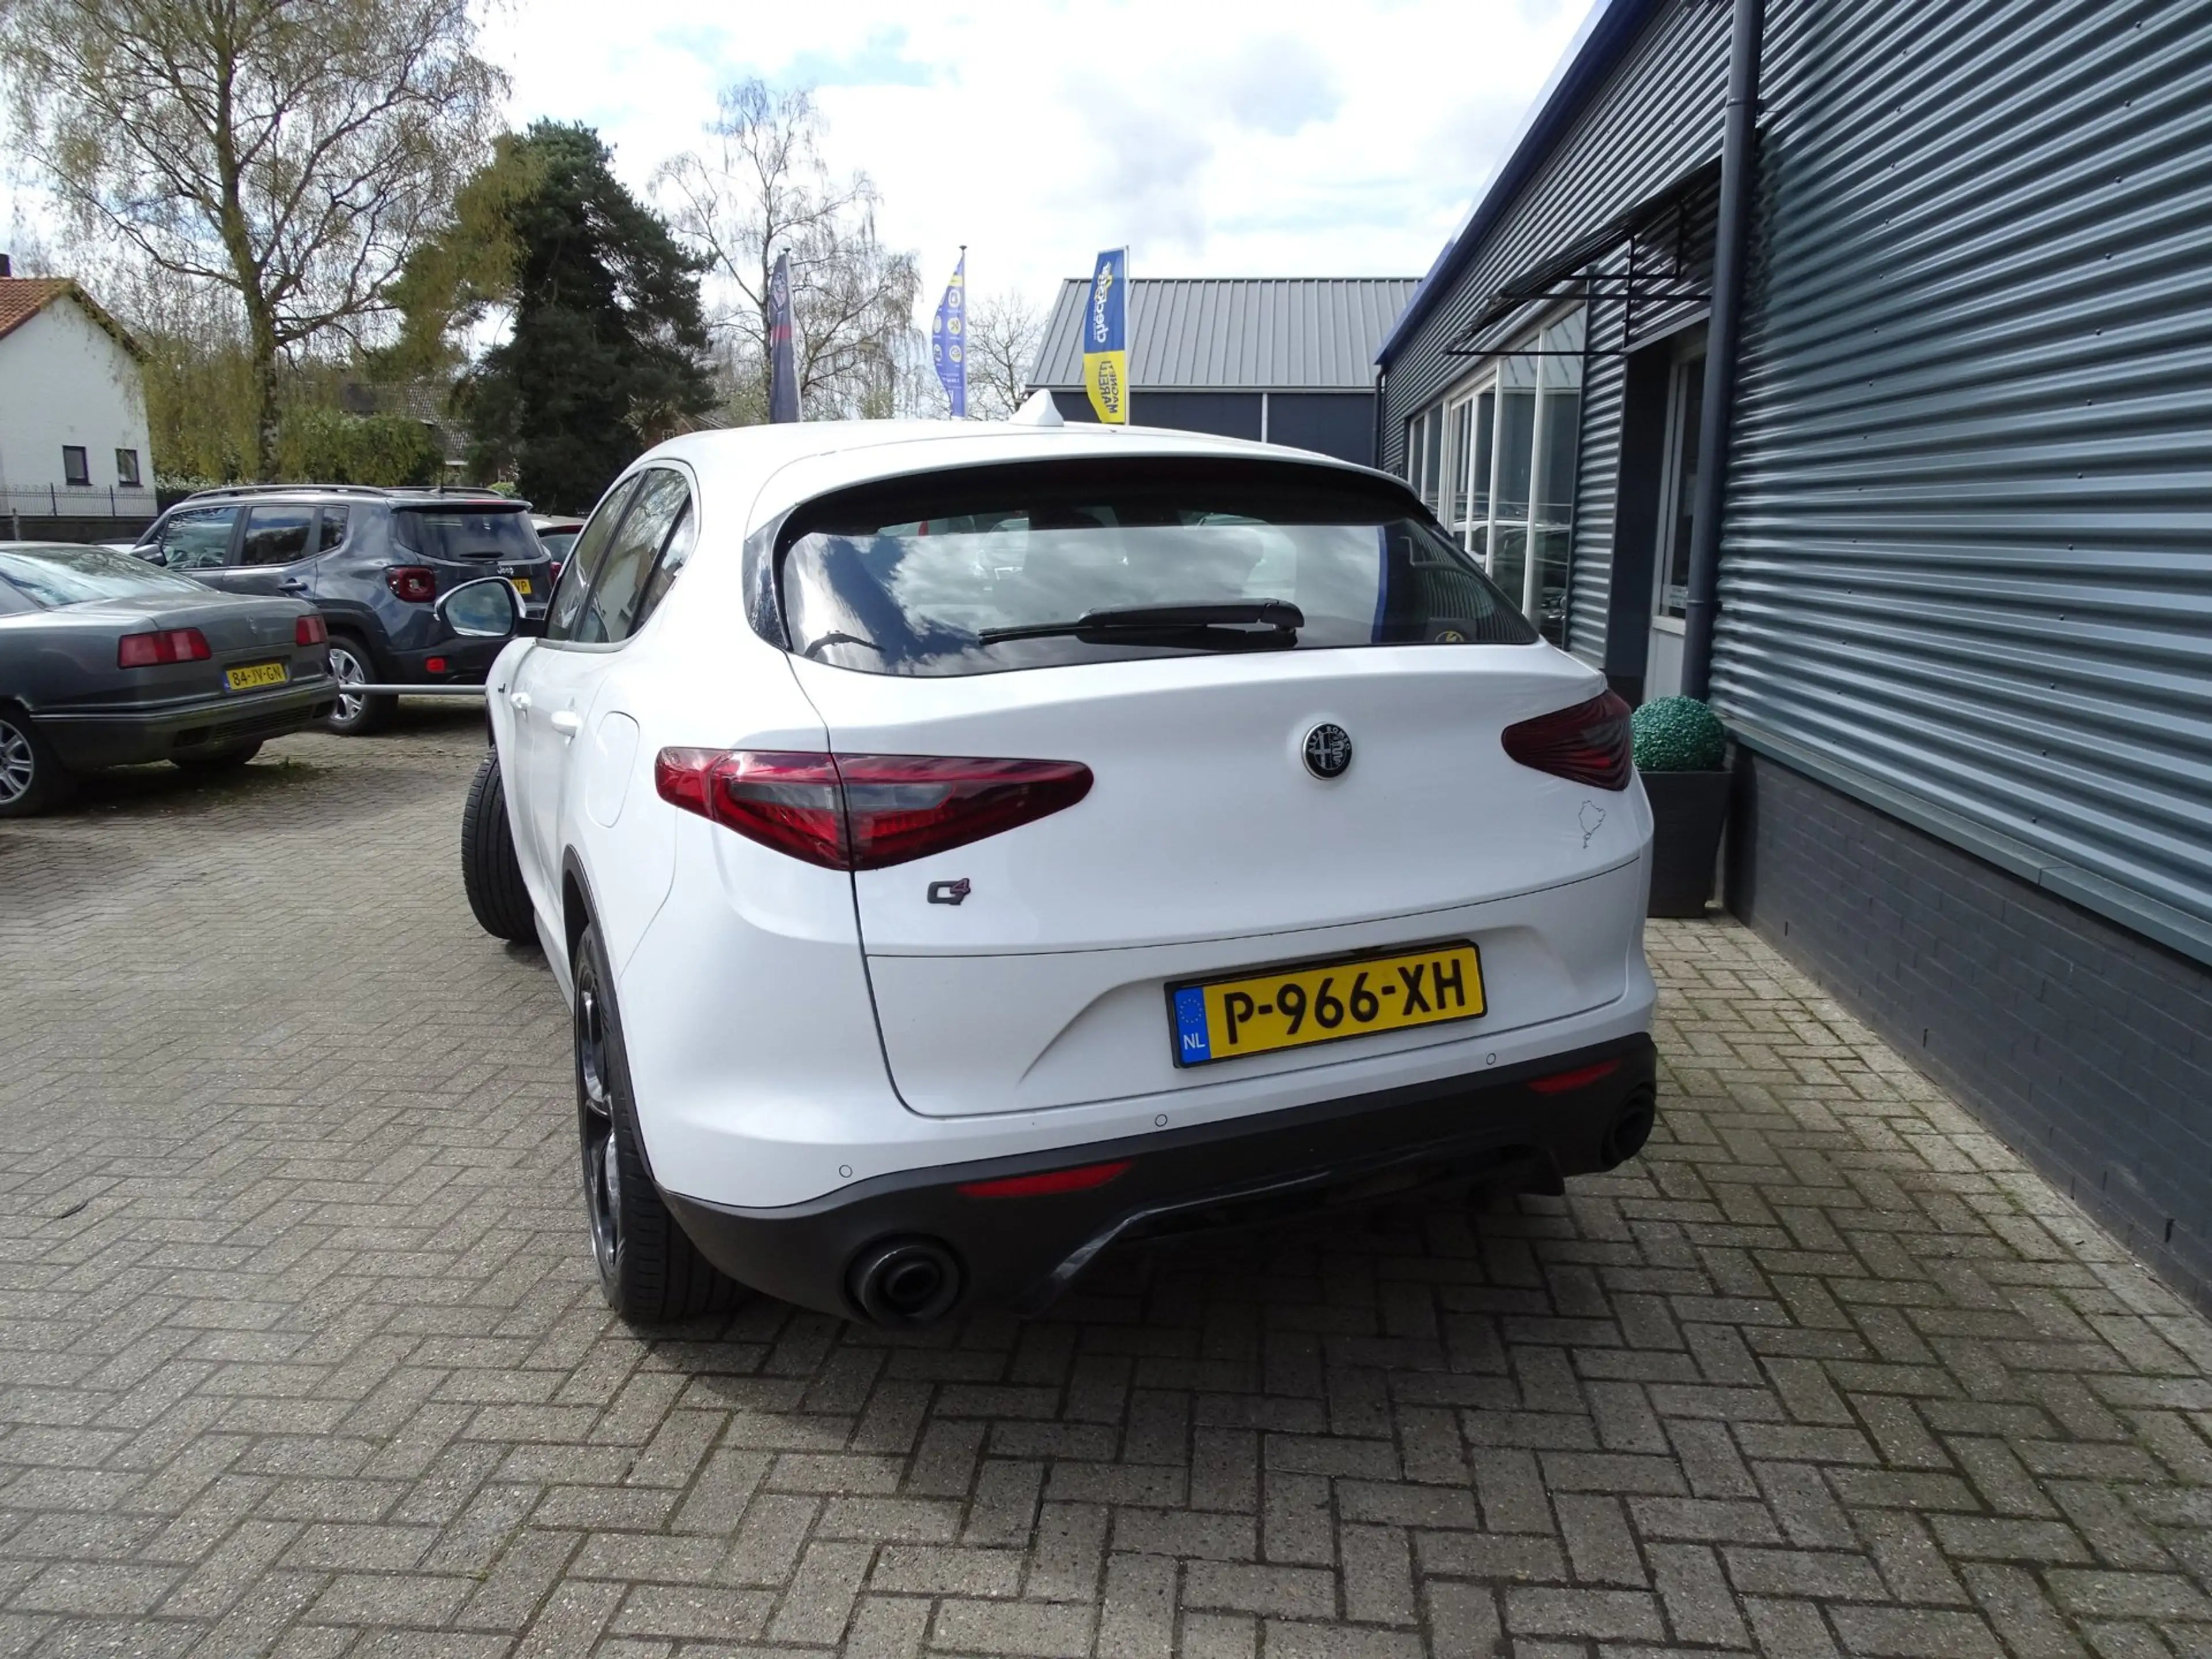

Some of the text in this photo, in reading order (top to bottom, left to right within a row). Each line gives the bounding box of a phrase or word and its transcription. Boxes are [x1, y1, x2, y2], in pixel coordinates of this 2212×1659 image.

[232, 665, 282, 685] 84-JV-GN
[1224, 959, 1465, 1044] P-966-XH
[1183, 1032, 1206, 1050] NL
